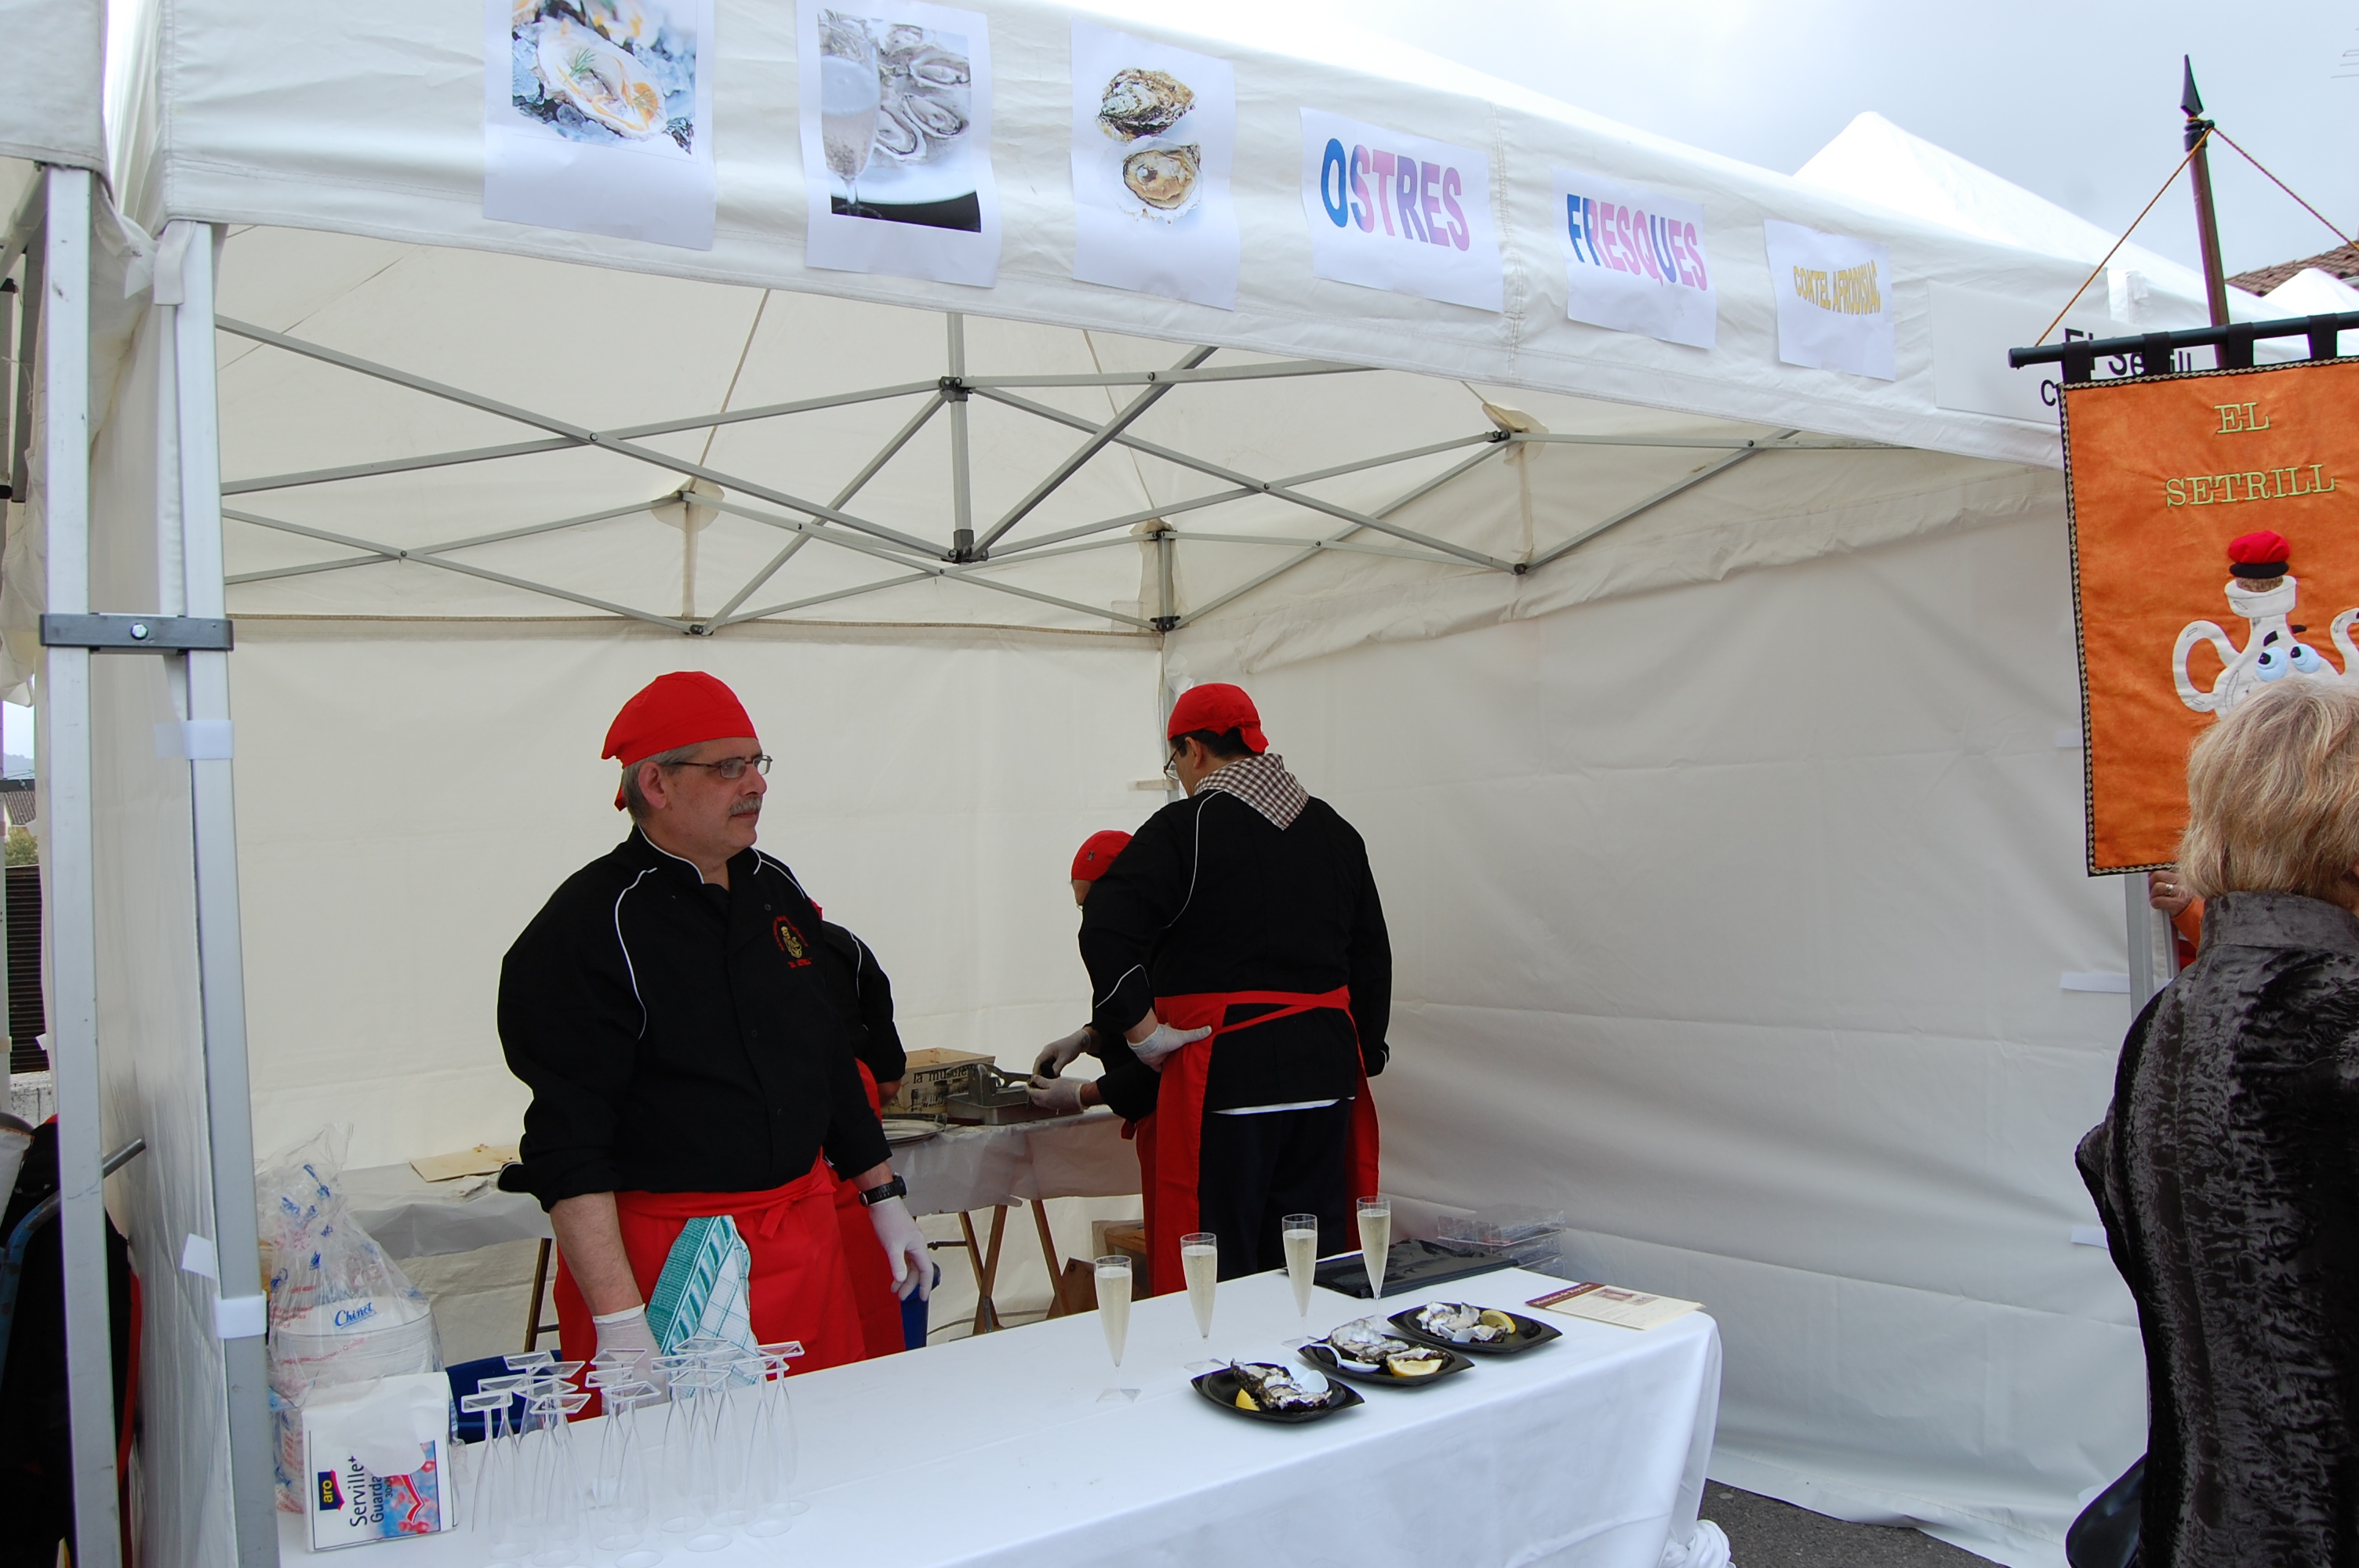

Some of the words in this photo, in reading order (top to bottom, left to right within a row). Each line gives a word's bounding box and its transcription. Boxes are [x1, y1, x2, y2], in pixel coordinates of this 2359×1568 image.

[1320, 137, 1470, 252] OSTRES
[1566, 193, 1708, 292] FRESQUES
[2213, 401, 2271, 434] EL
[2165, 463, 2336, 508] SETRILL
[334, 1301, 373, 1327] Chinet
[322, 1479, 333, 1504] aro
[368, 1476, 384, 1523] Guarda
